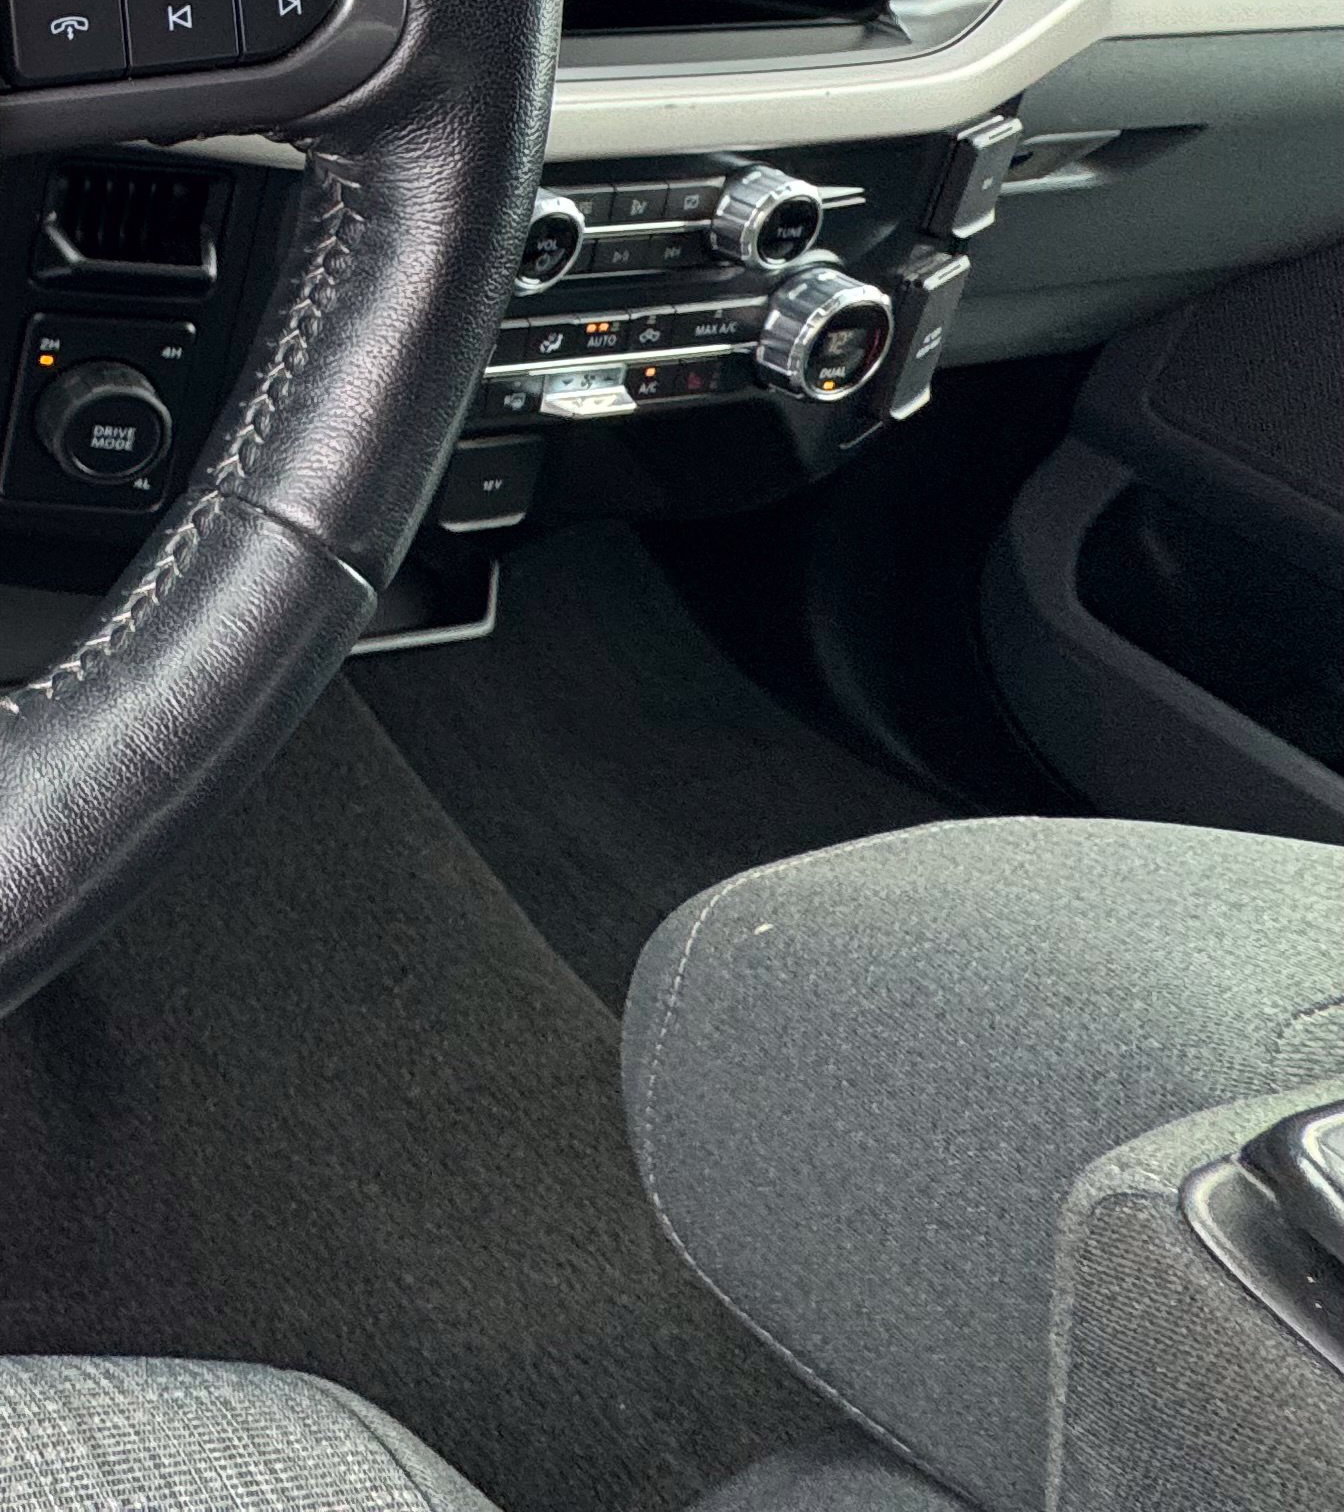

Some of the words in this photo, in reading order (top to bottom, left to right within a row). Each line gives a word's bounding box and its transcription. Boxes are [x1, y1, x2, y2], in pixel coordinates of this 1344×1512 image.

[536, 239, 558, 252] VOL
[587, 334, 617, 348] AUTO
[92, 425, 136, 439] DRIVE
[90, 438, 134, 452] MODE
